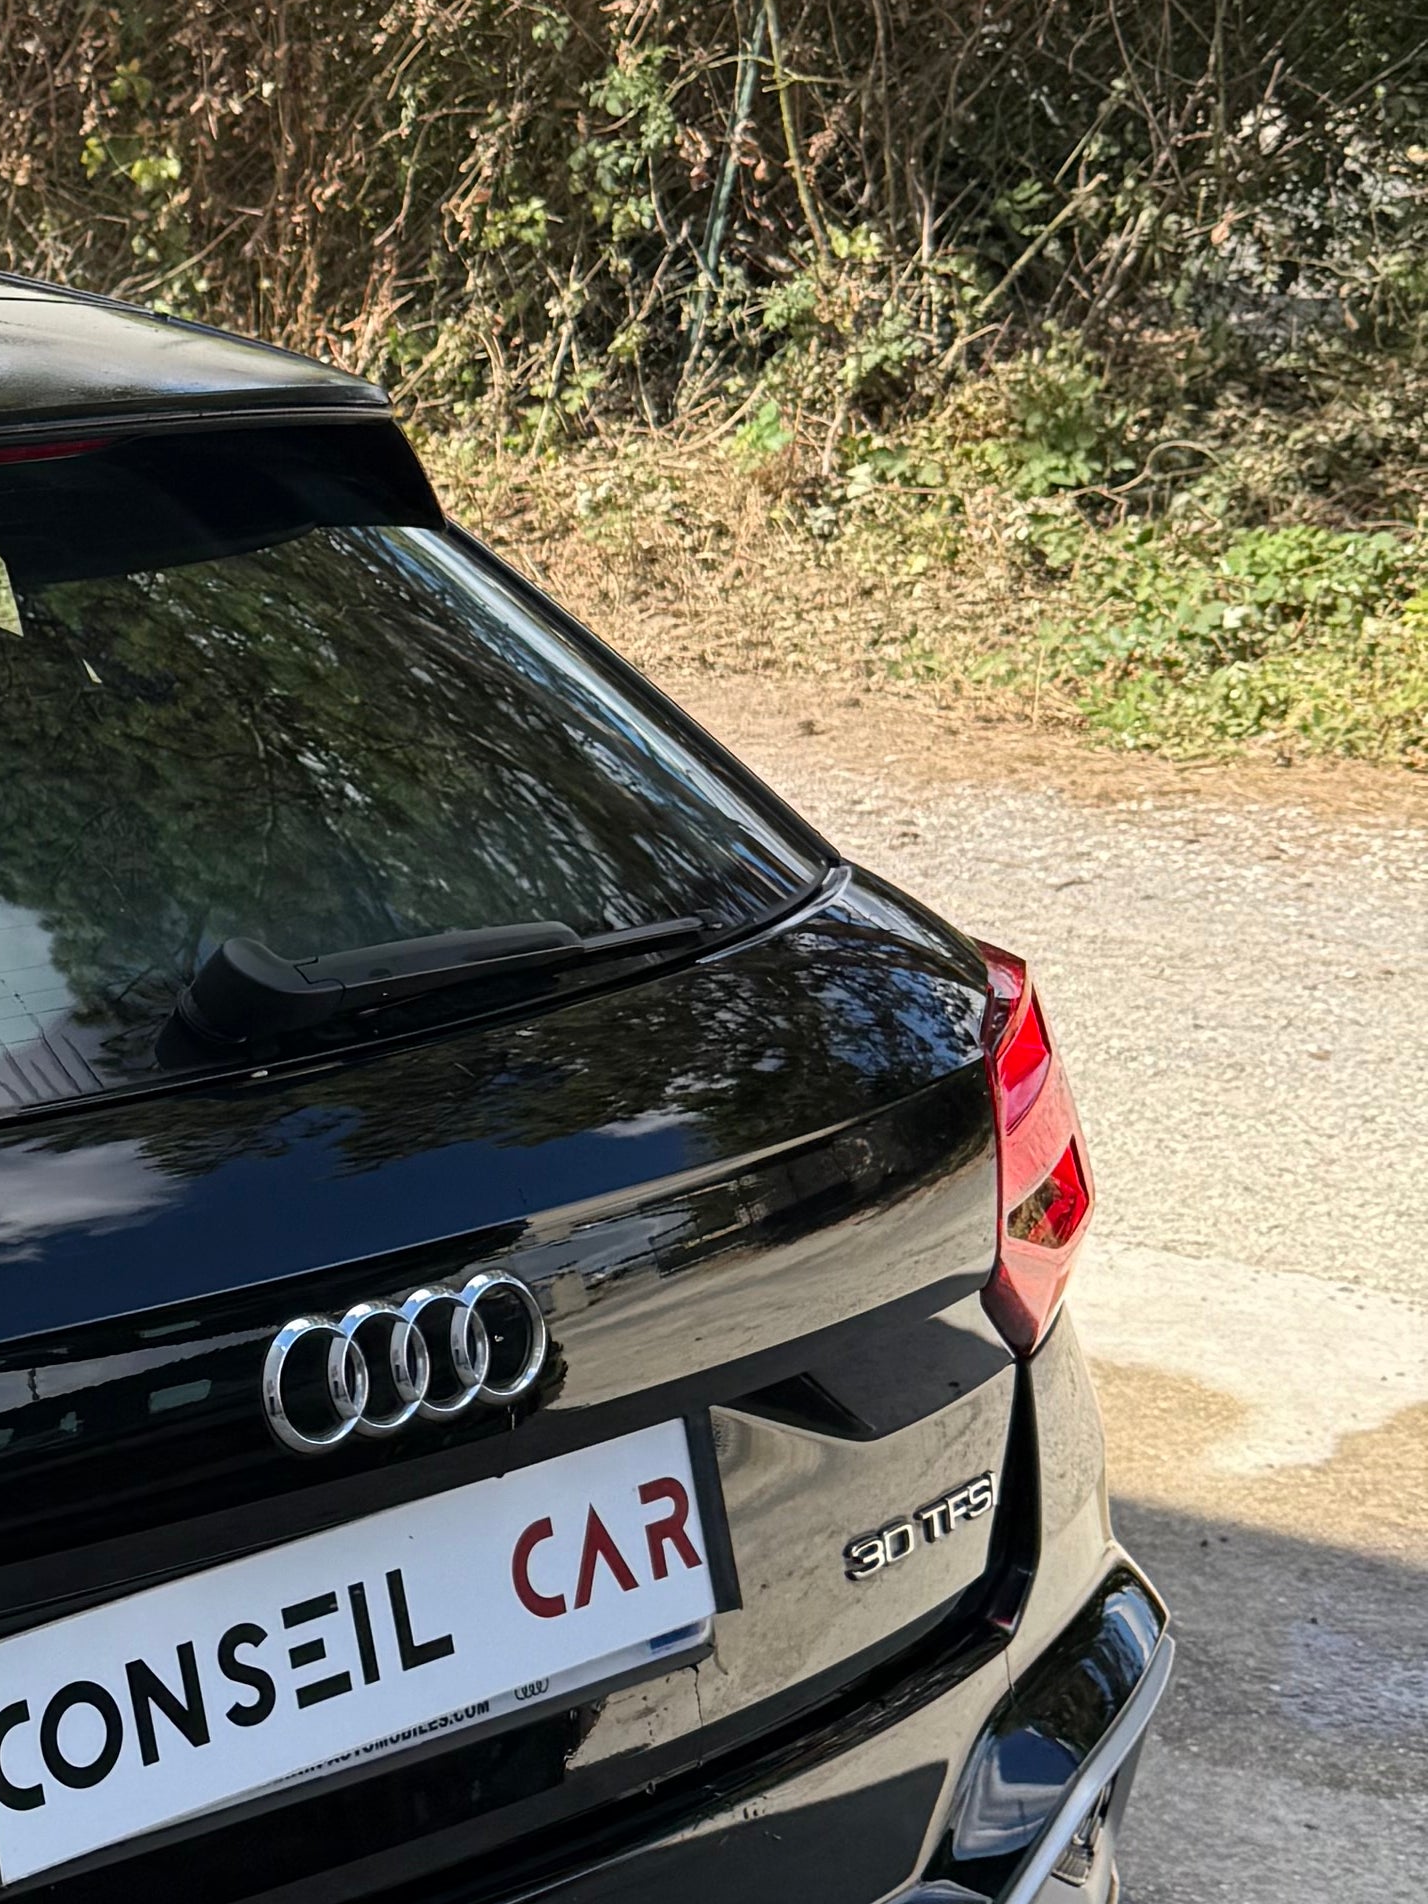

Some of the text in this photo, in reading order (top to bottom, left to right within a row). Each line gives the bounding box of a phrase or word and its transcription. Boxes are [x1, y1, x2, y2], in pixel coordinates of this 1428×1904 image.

[511, 1476, 703, 1619] CAR
[844, 1470, 998, 1581] 30 TFSI
